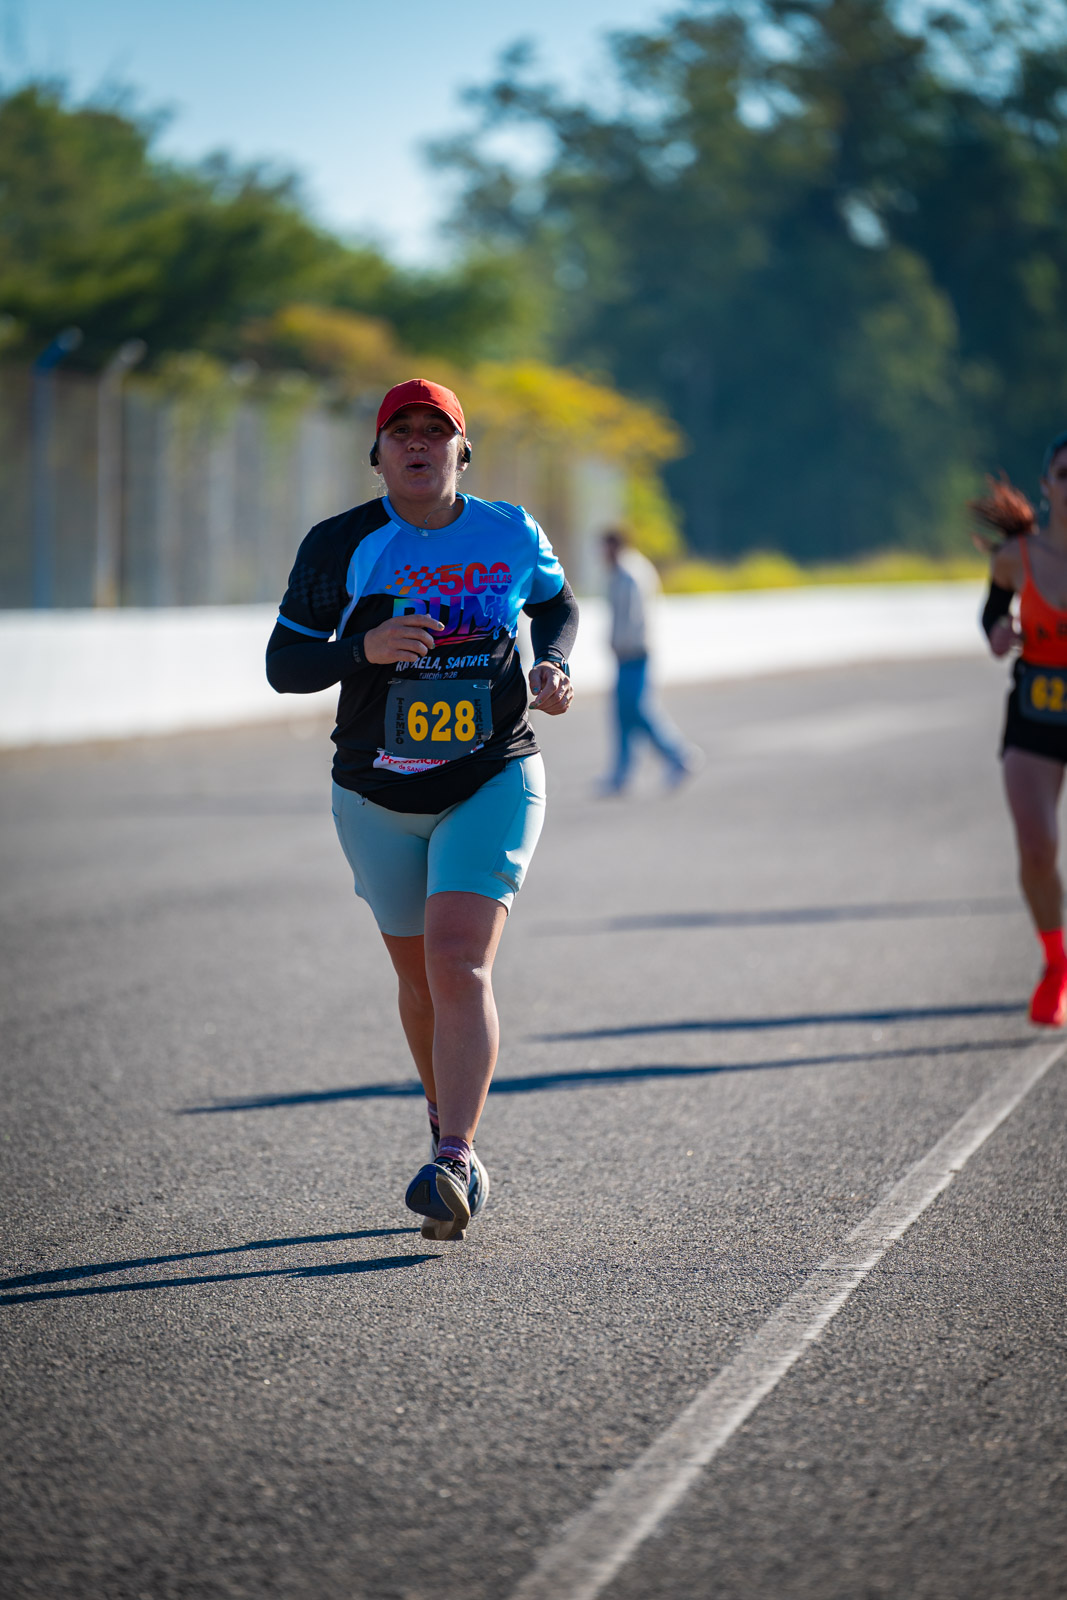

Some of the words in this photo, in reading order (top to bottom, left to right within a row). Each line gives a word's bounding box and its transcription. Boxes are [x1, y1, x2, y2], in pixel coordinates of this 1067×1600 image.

[438, 562, 511, 596] 500
[479, 575, 512, 584] MILLAS
[1031, 675, 1067, 712] 62
[396, 697, 405, 744] TIEMPO
[407, 700, 476, 742] 628
